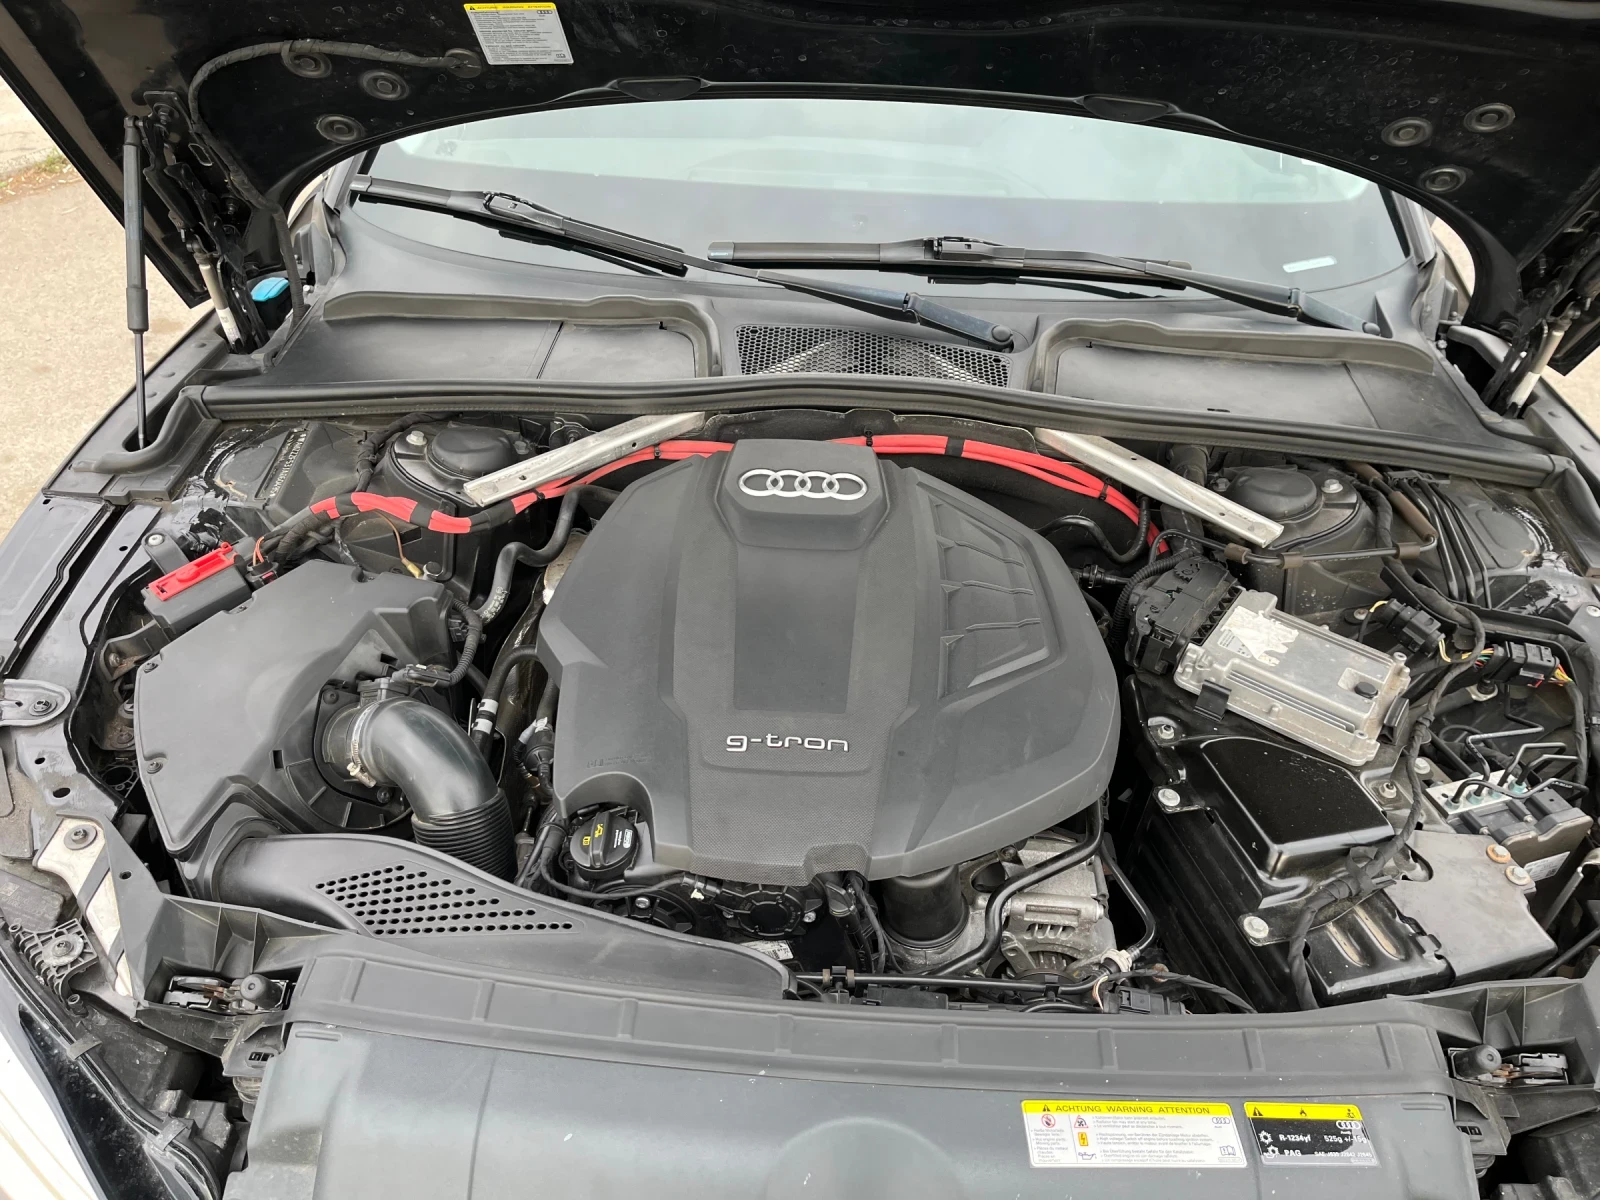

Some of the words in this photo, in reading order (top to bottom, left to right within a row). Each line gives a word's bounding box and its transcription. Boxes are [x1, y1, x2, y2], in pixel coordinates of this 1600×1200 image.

[725, 733, 850, 753] g-tron
[1055, 1105, 1102, 1113] ACHTUNG
[1106, 1105, 1153, 1114] WARNING
[1158, 1106, 1210, 1115] ATTENTION
[1278, 1133, 1312, 1143] R-1234yf
[1323, 1135, 1343, 1144] 525g
[1283, 1149, 1302, 1157] PAG
